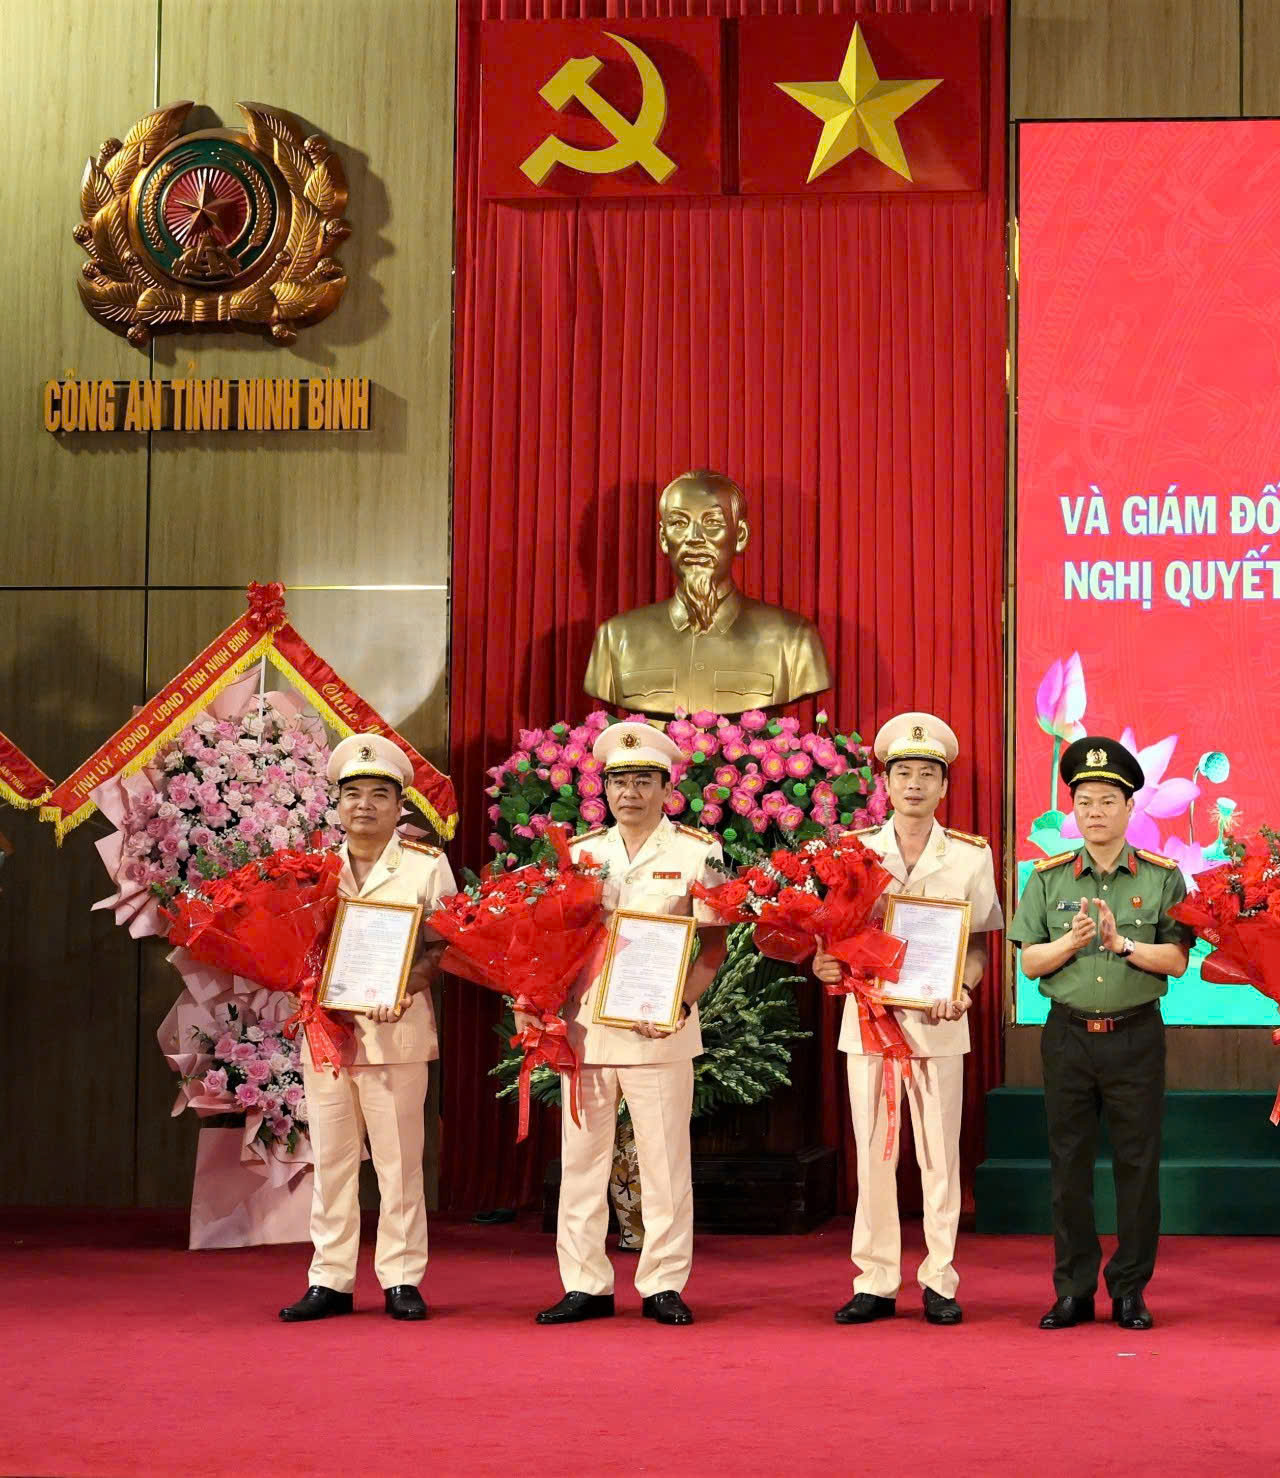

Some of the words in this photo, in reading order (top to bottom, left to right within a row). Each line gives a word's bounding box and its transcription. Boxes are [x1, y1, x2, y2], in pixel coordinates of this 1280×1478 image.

[44, 367, 116, 432] CÔNG
[124, 378, 162, 432] AN
[171, 359, 230, 432] TỈNH
[237, 378, 301, 431] NINH
[307, 366, 370, 431] BÌNH
[1059, 485, 1110, 535] VÀ
[1121, 484, 1217, 536] GIÁM
[1064, 560, 1152, 610] NGHỊ
[71, 771, 100, 798] TỈNH
[93, 755, 114, 775] ỦY
[117, 724, 150, 755] HĐND
[152, 692, 185, 722] UBND
[204, 646, 233, 673] NINH
